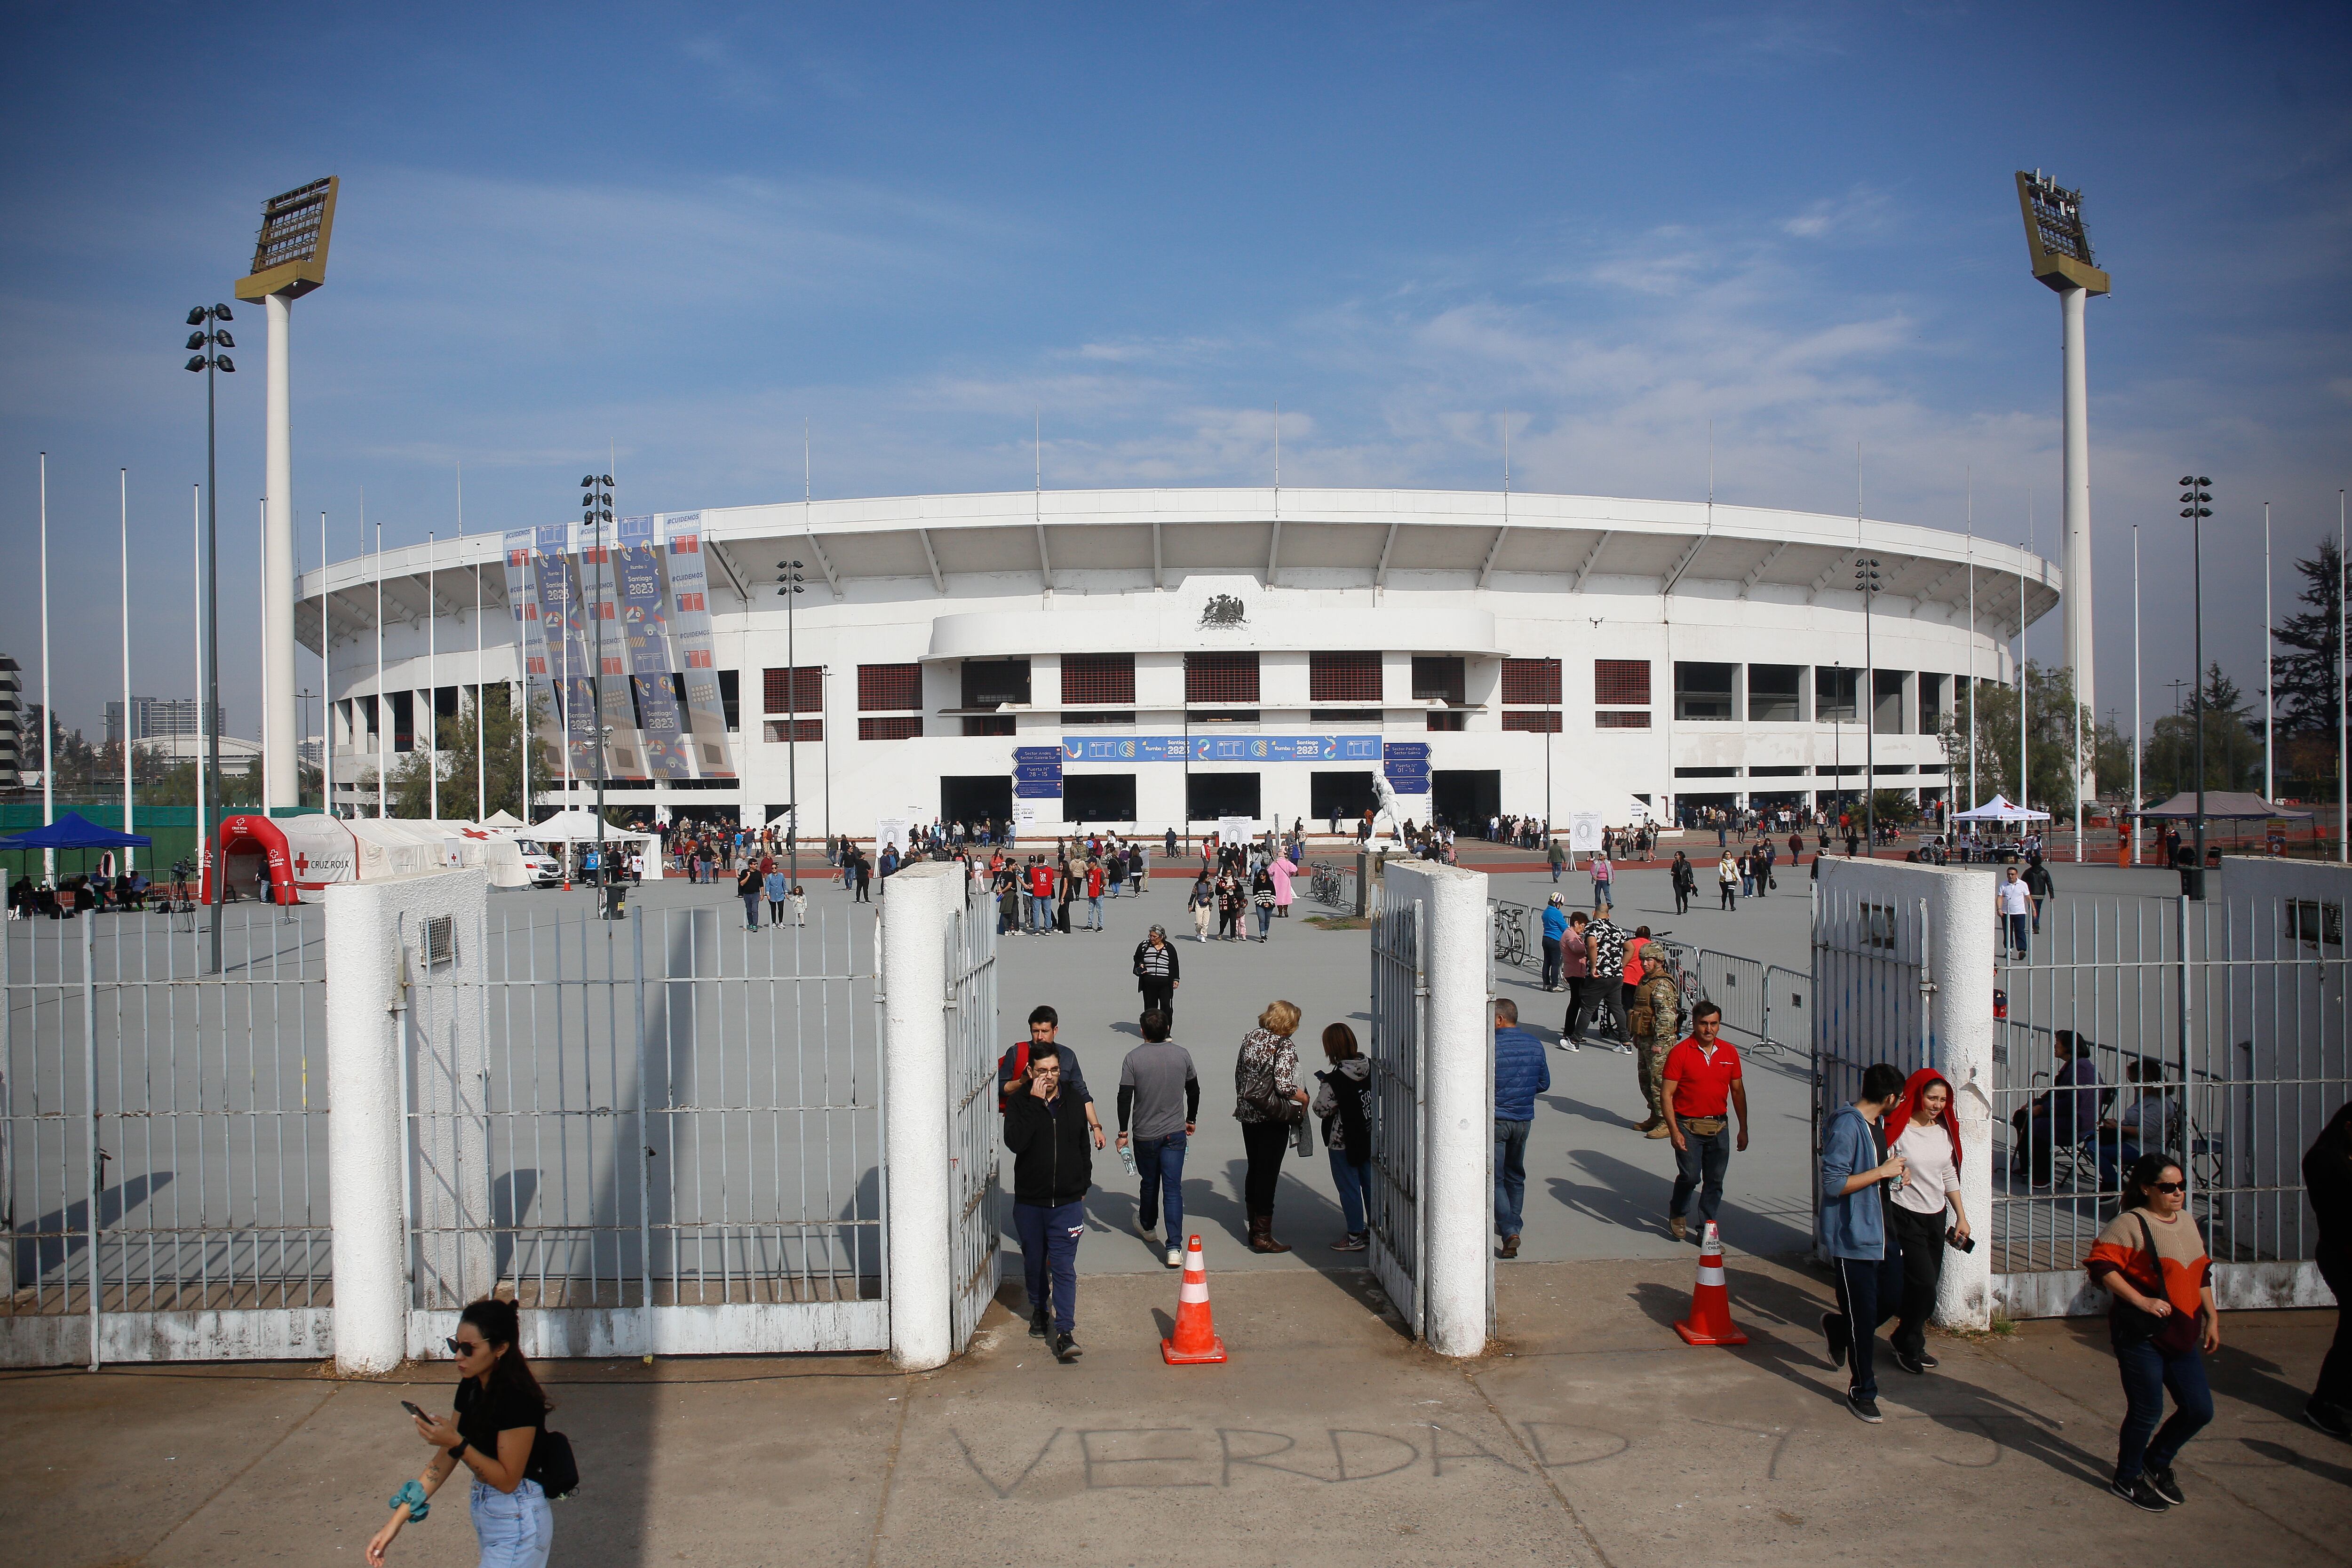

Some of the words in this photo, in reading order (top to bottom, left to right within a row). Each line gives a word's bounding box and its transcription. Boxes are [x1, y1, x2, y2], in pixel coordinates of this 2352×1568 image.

[667, 514, 699, 525] #CUIDEMOS
[580, 525, 609, 535] #CUIDMOS
[670, 521, 700, 531] NACIONAL
[506, 529, 530, 539] #CUIDEMOS
[672, 572, 703, 582] #CUIDEMOS
[510, 584, 534, 593] #CUIDMOS
[585, 582, 613, 591] #CUIEMOS
[629, 583, 653, 595] 2023
[680, 629, 710, 639] #CUIDEMOS
[649, 718, 674, 728] 2023
[1296, 746, 1319, 755] 2023
[1360, 1090, 1372, 1107] SER
[1363, 1104, 1372, 1120] VE
[949, 1421, 1629, 1499] VERDAD
